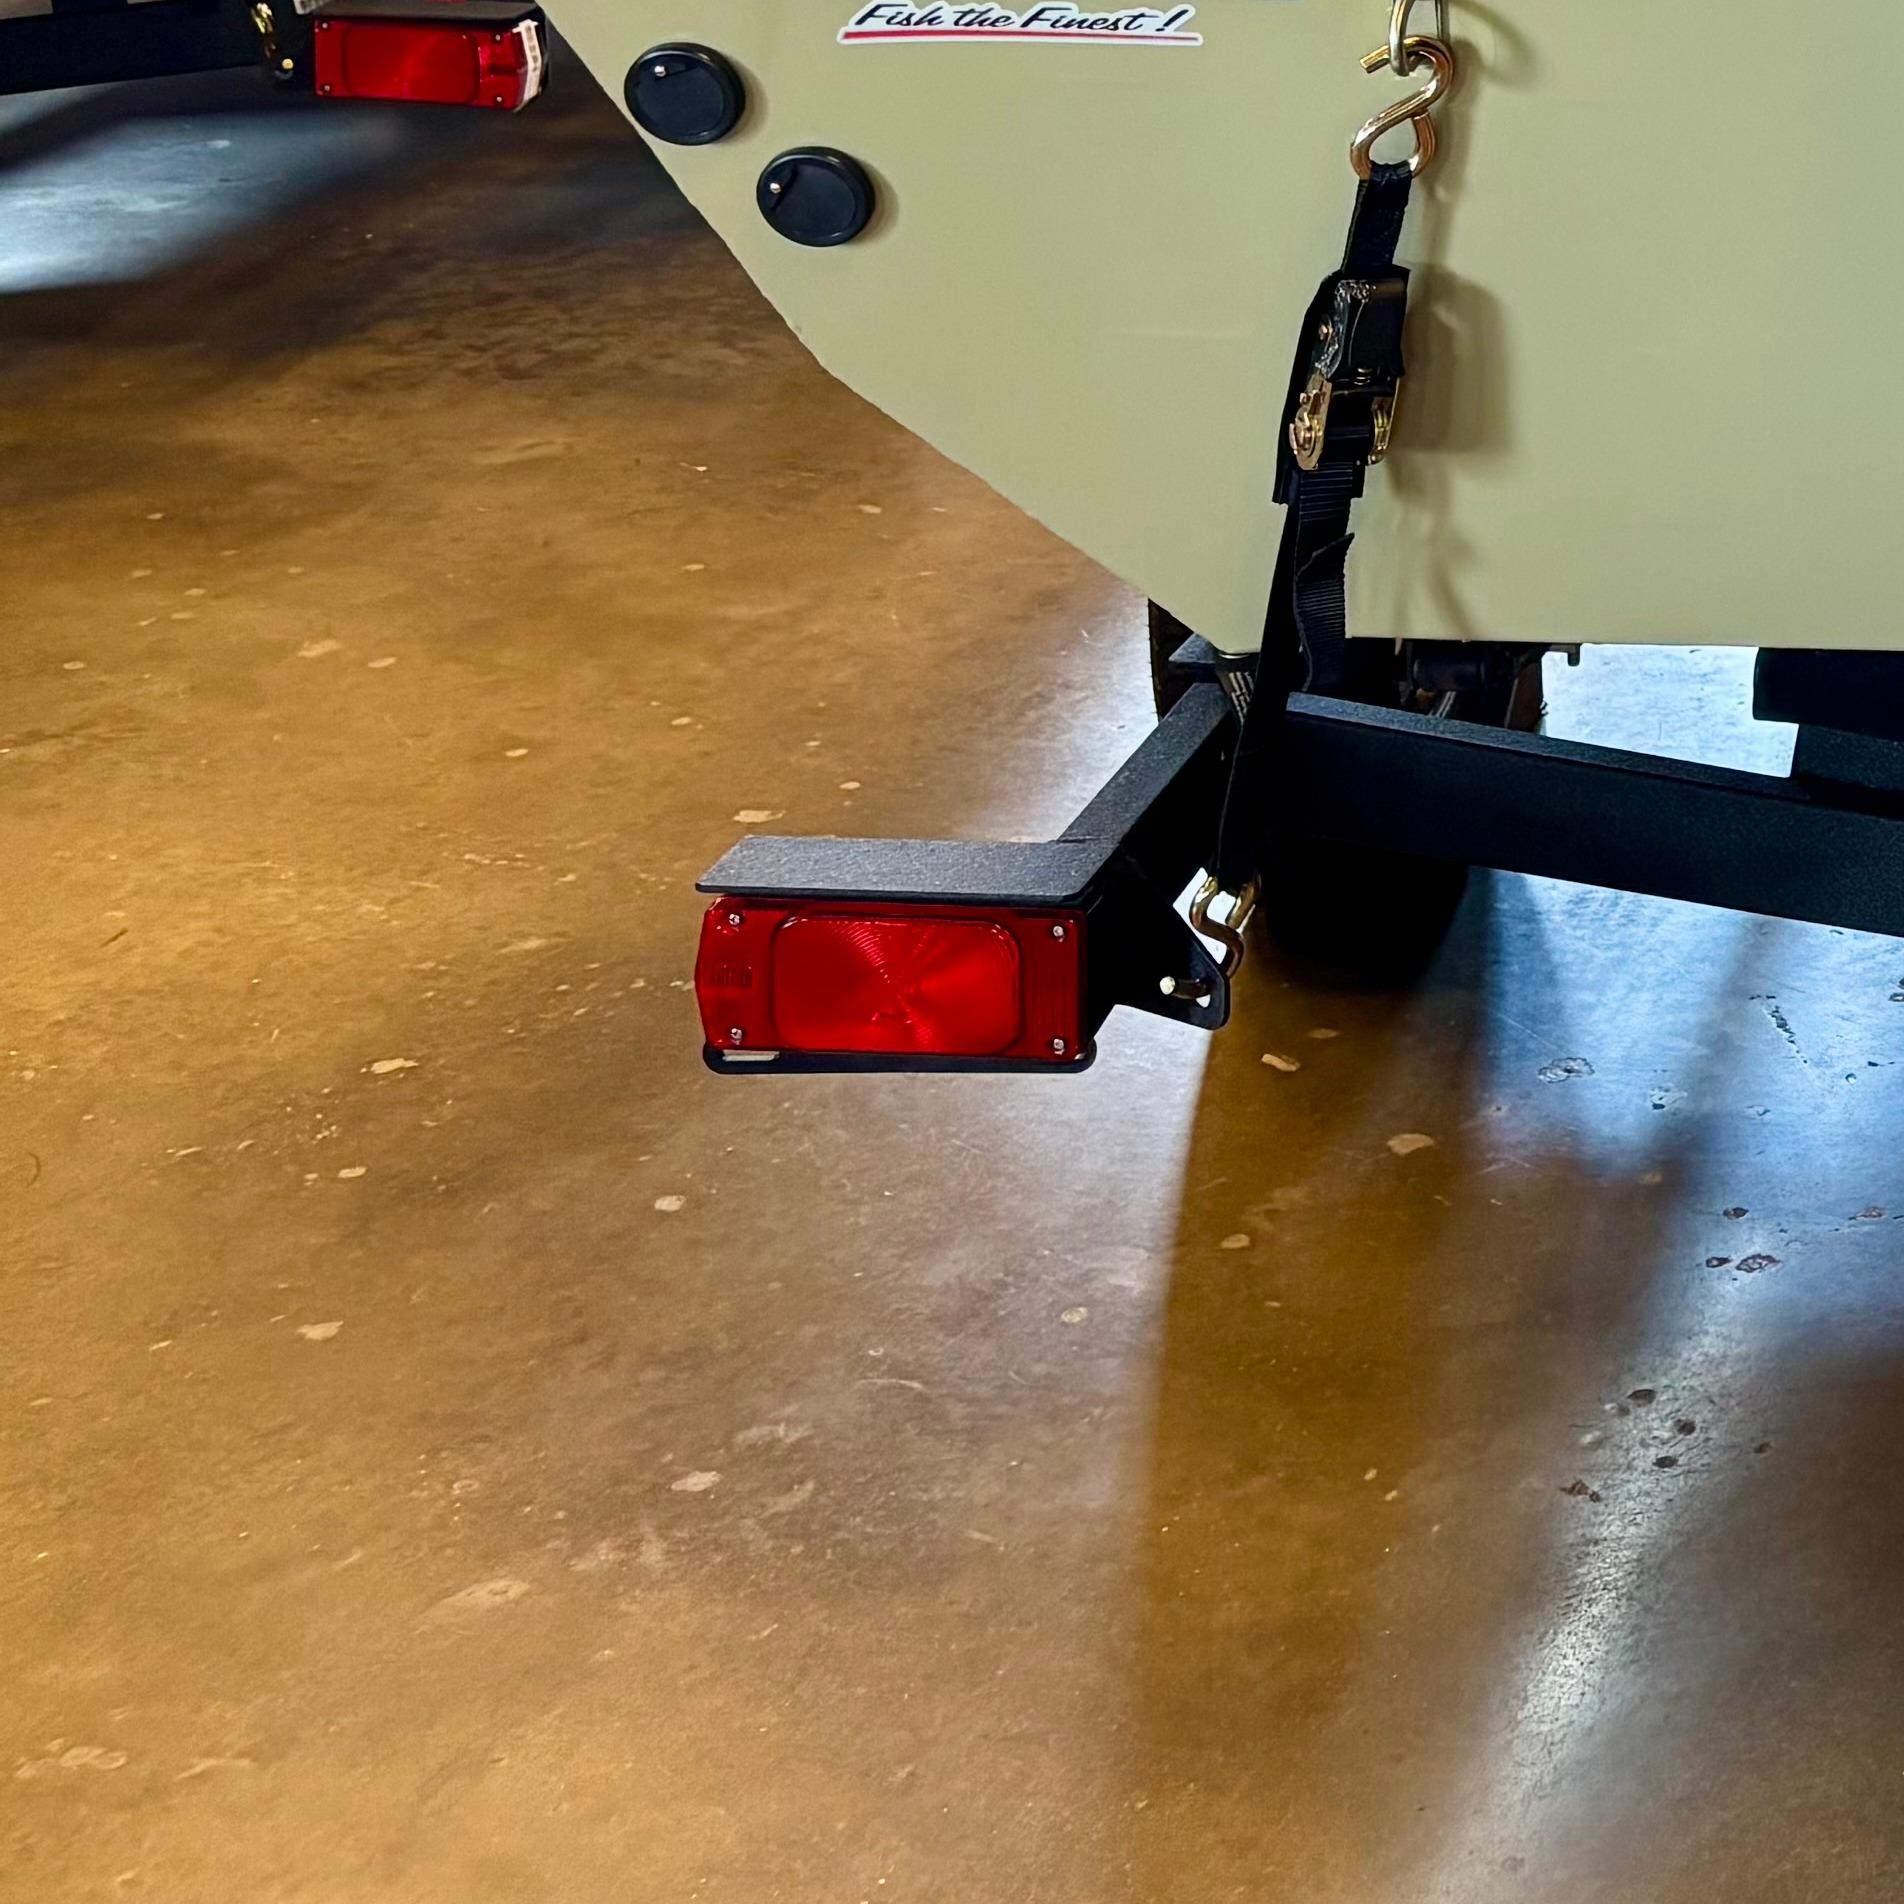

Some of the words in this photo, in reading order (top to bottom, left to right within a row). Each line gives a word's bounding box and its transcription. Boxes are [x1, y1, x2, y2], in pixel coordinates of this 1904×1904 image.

[856, 4, 944, 27] Fish
[953, 4, 1016, 28] the
[1021, 7, 1146, 33] Finest
